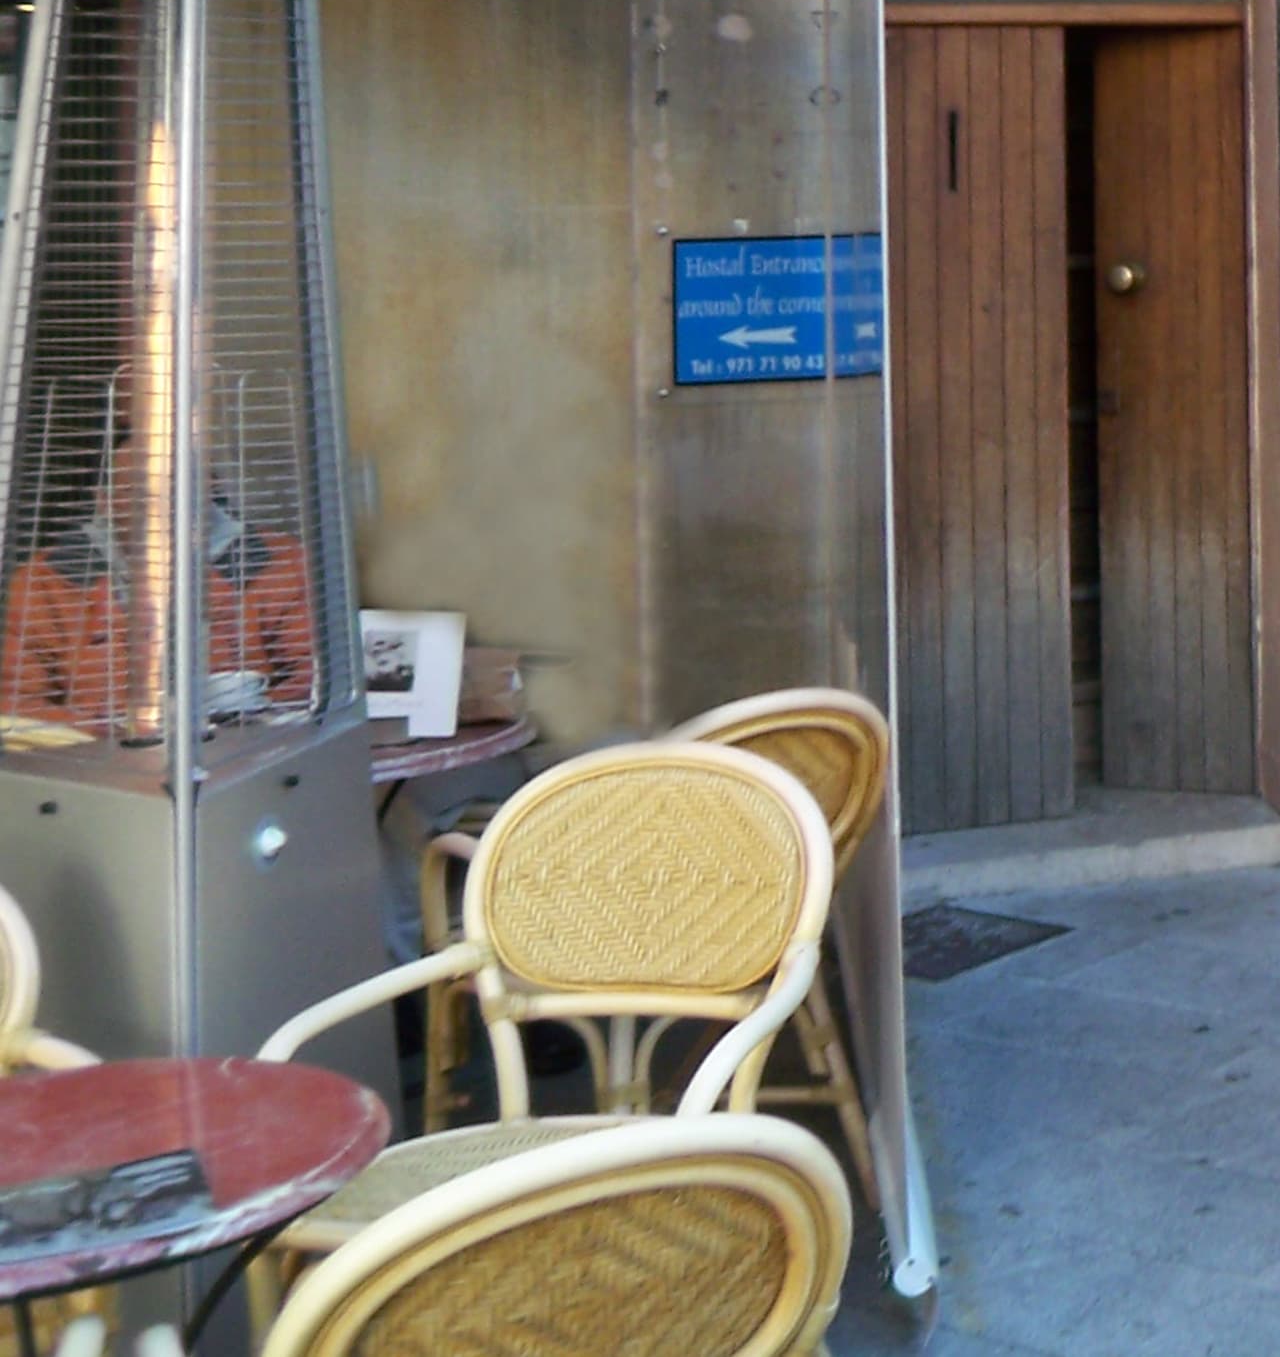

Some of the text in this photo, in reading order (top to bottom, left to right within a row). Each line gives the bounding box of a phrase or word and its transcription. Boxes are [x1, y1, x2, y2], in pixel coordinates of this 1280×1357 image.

[685, 246, 744, 278] Hostal
[679, 293, 742, 319] around
[748, 284, 773, 317] the
[726, 356, 753, 374] 971
[760, 355, 777, 373] 71
[783, 354, 801, 372] 90
[806, 353, 824, 371] 43
